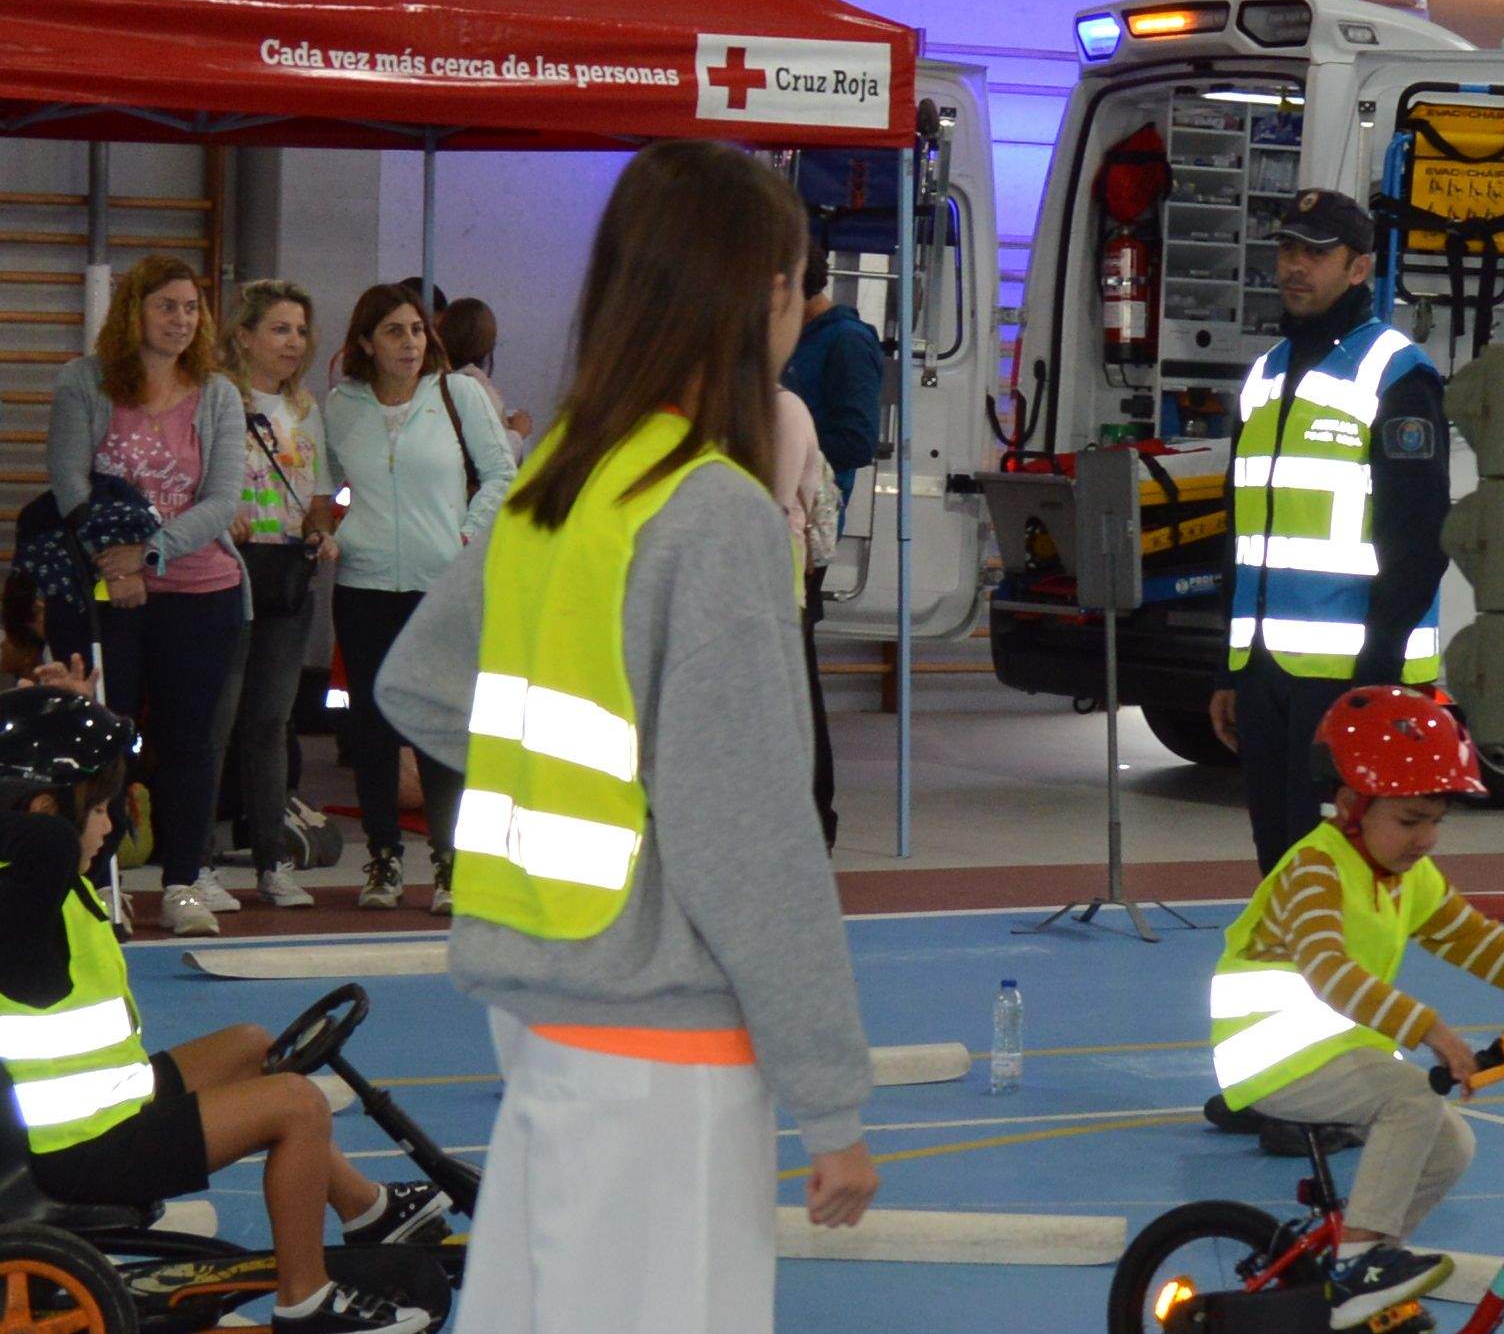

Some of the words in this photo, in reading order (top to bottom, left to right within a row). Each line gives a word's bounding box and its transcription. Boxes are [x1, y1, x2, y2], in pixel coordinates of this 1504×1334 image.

[261, 39, 325, 69] Cada
[330, 51, 370, 71] vez
[375, 47, 426, 76] más
[432, 57, 496, 79] cerca
[501, 55, 531, 80] de
[536, 56, 571, 82] las
[575, 65, 680, 88] personas
[776, 67, 827, 94] Cruz
[834, 70, 880, 102] Roja
